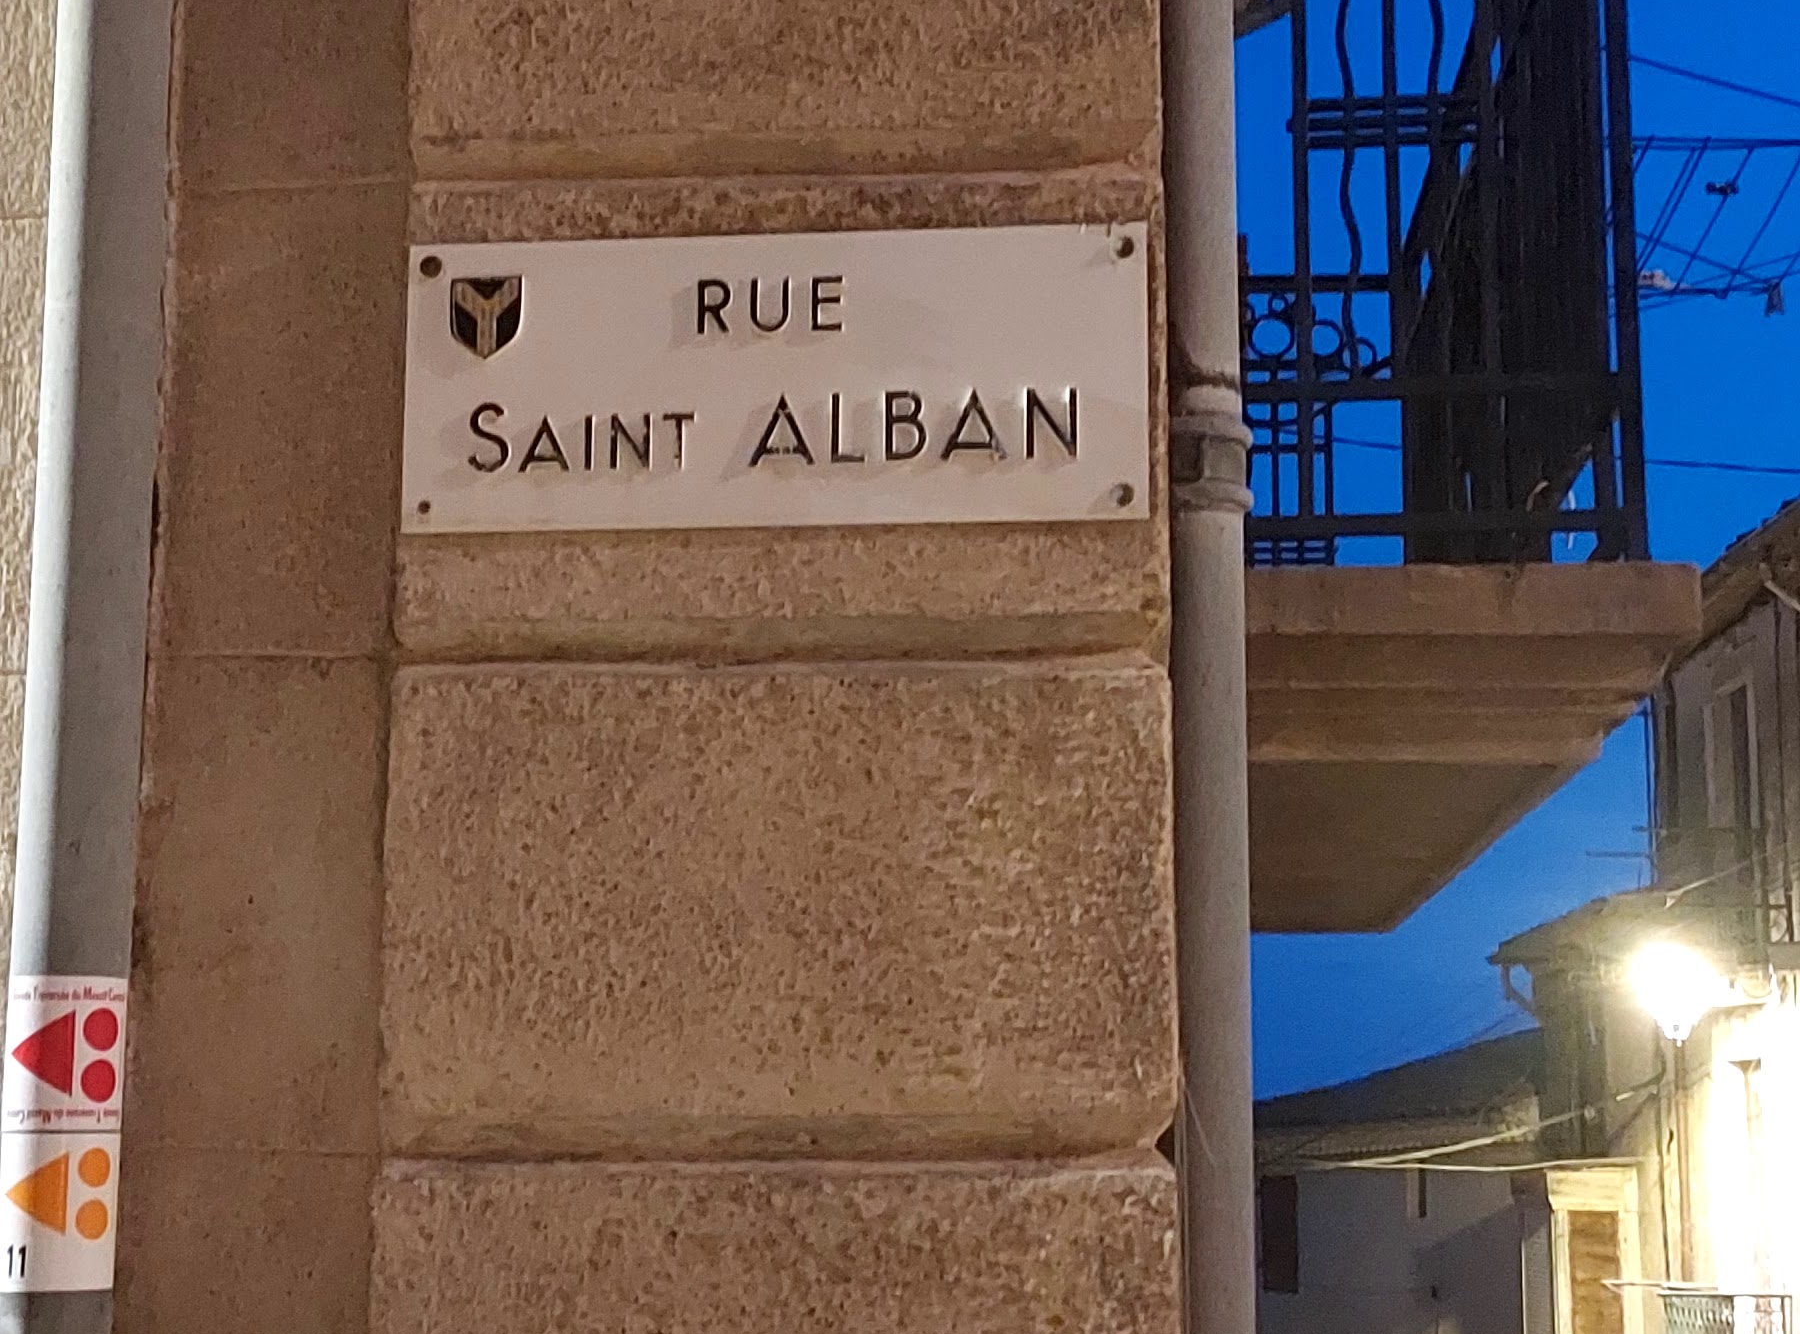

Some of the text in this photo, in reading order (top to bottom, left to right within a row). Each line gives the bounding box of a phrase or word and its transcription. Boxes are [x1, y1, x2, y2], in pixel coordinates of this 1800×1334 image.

[696, 275, 844, 335] RUE
[467, 386, 1078, 473] SAINT ALBAN
[7, 1244, 27, 1279] 11
